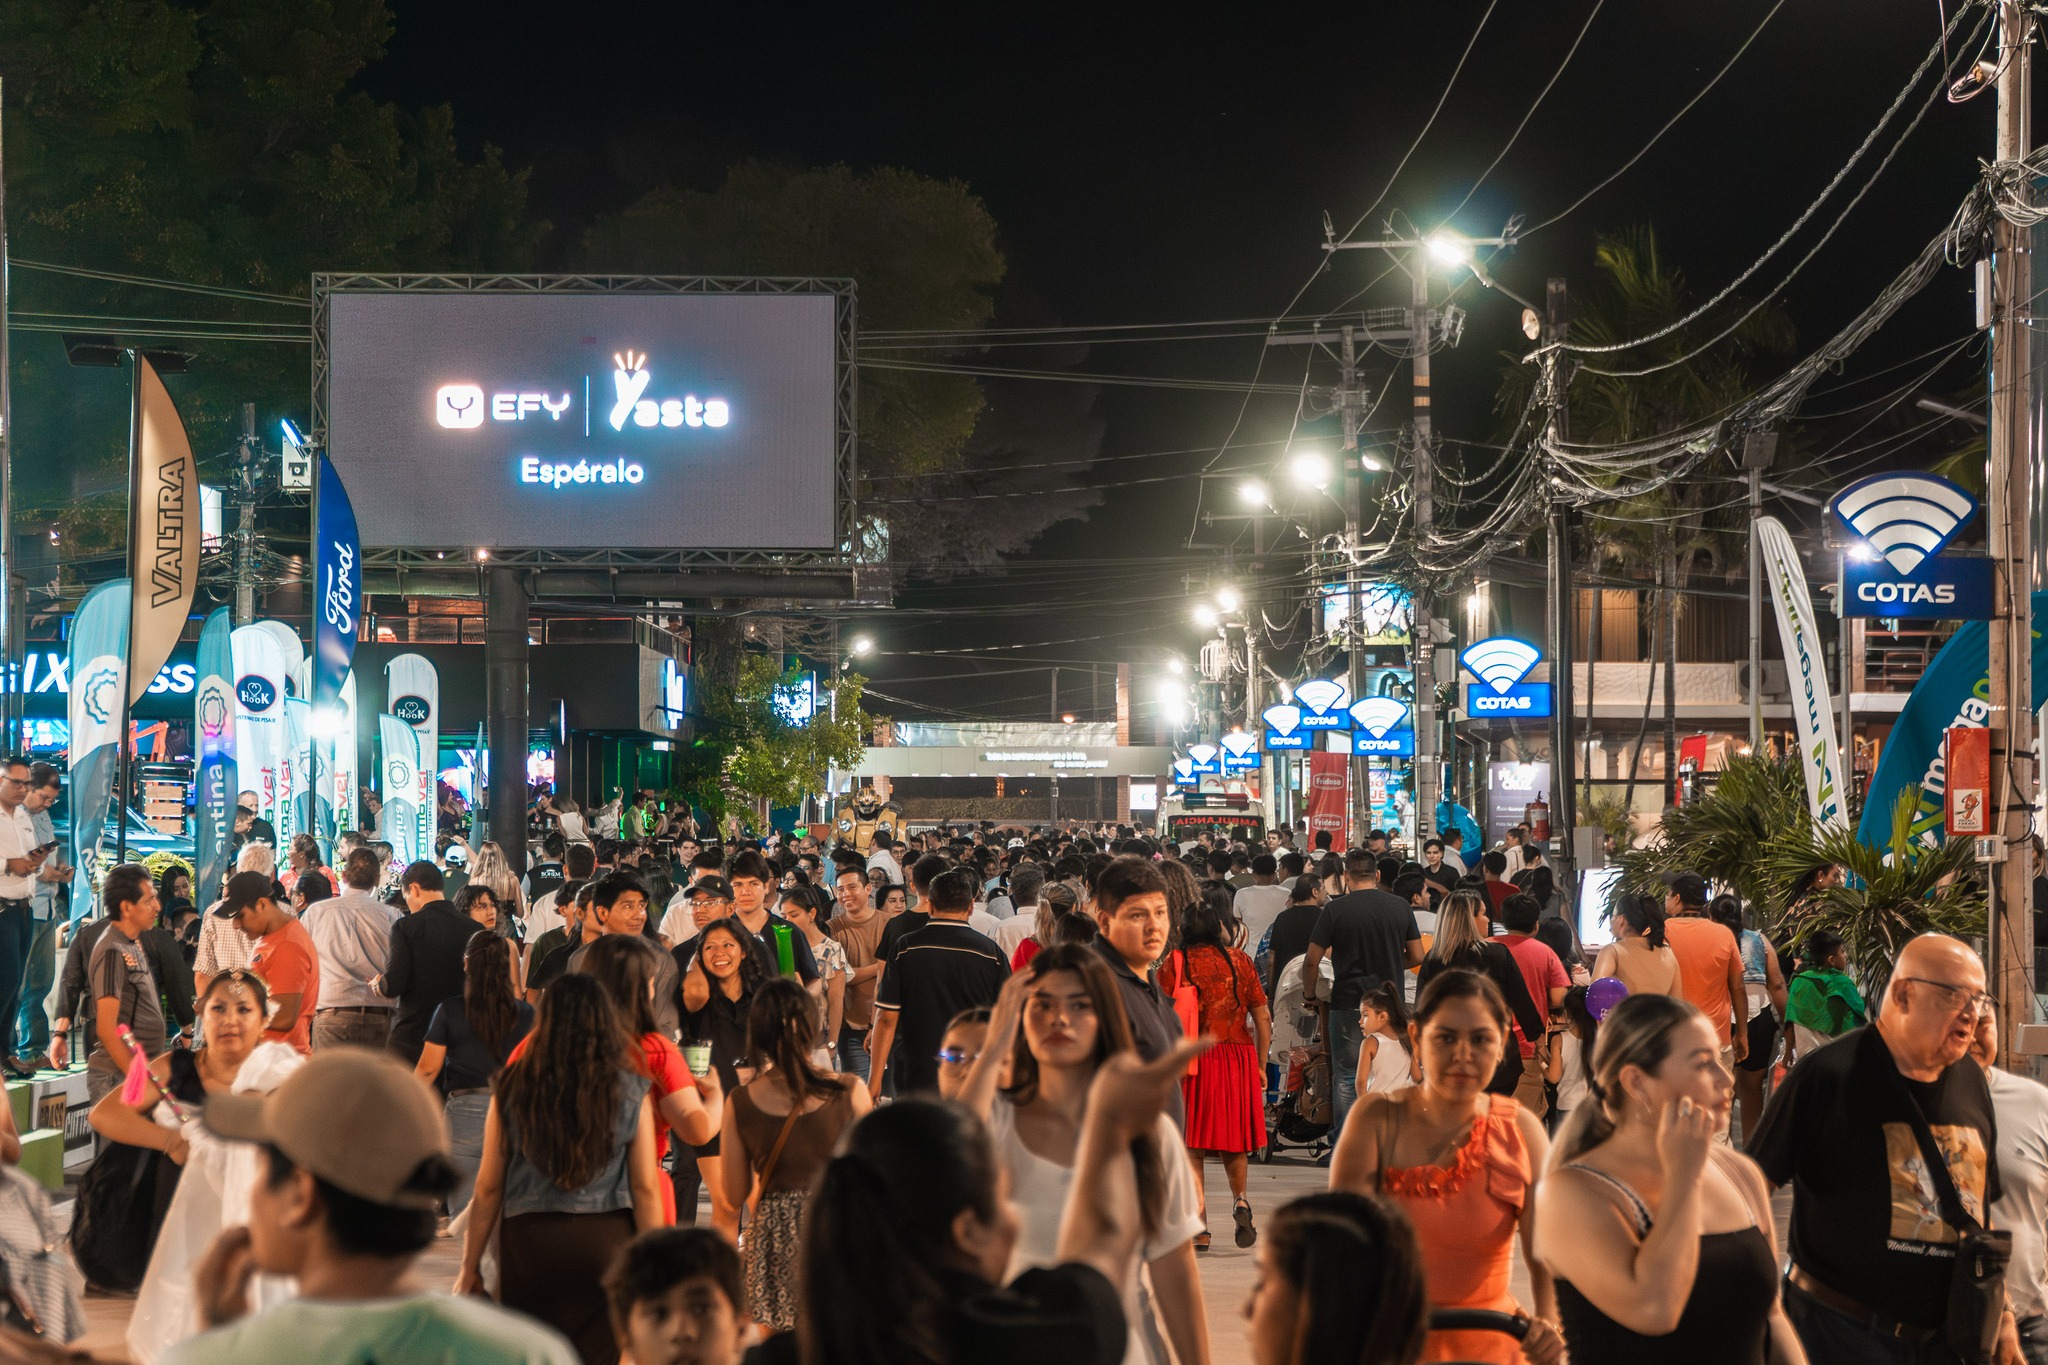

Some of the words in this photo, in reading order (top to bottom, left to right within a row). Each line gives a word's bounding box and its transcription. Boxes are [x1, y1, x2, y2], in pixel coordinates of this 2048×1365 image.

[492, 393, 571, 421] EFY
[521, 457, 644, 489] Espéralo
[152, 457, 185, 609] VALTRA
[326, 541, 353, 634] Ford
[1857, 582, 1955, 604] COTAS
[1476, 695, 1531, 710] COTAS
[1303, 716, 1339, 725] COTAS
[1270, 737, 1302, 745] COTAS
[1358, 740, 1400, 750] COTAS
[1315, 777, 1342, 786] Fridosa
